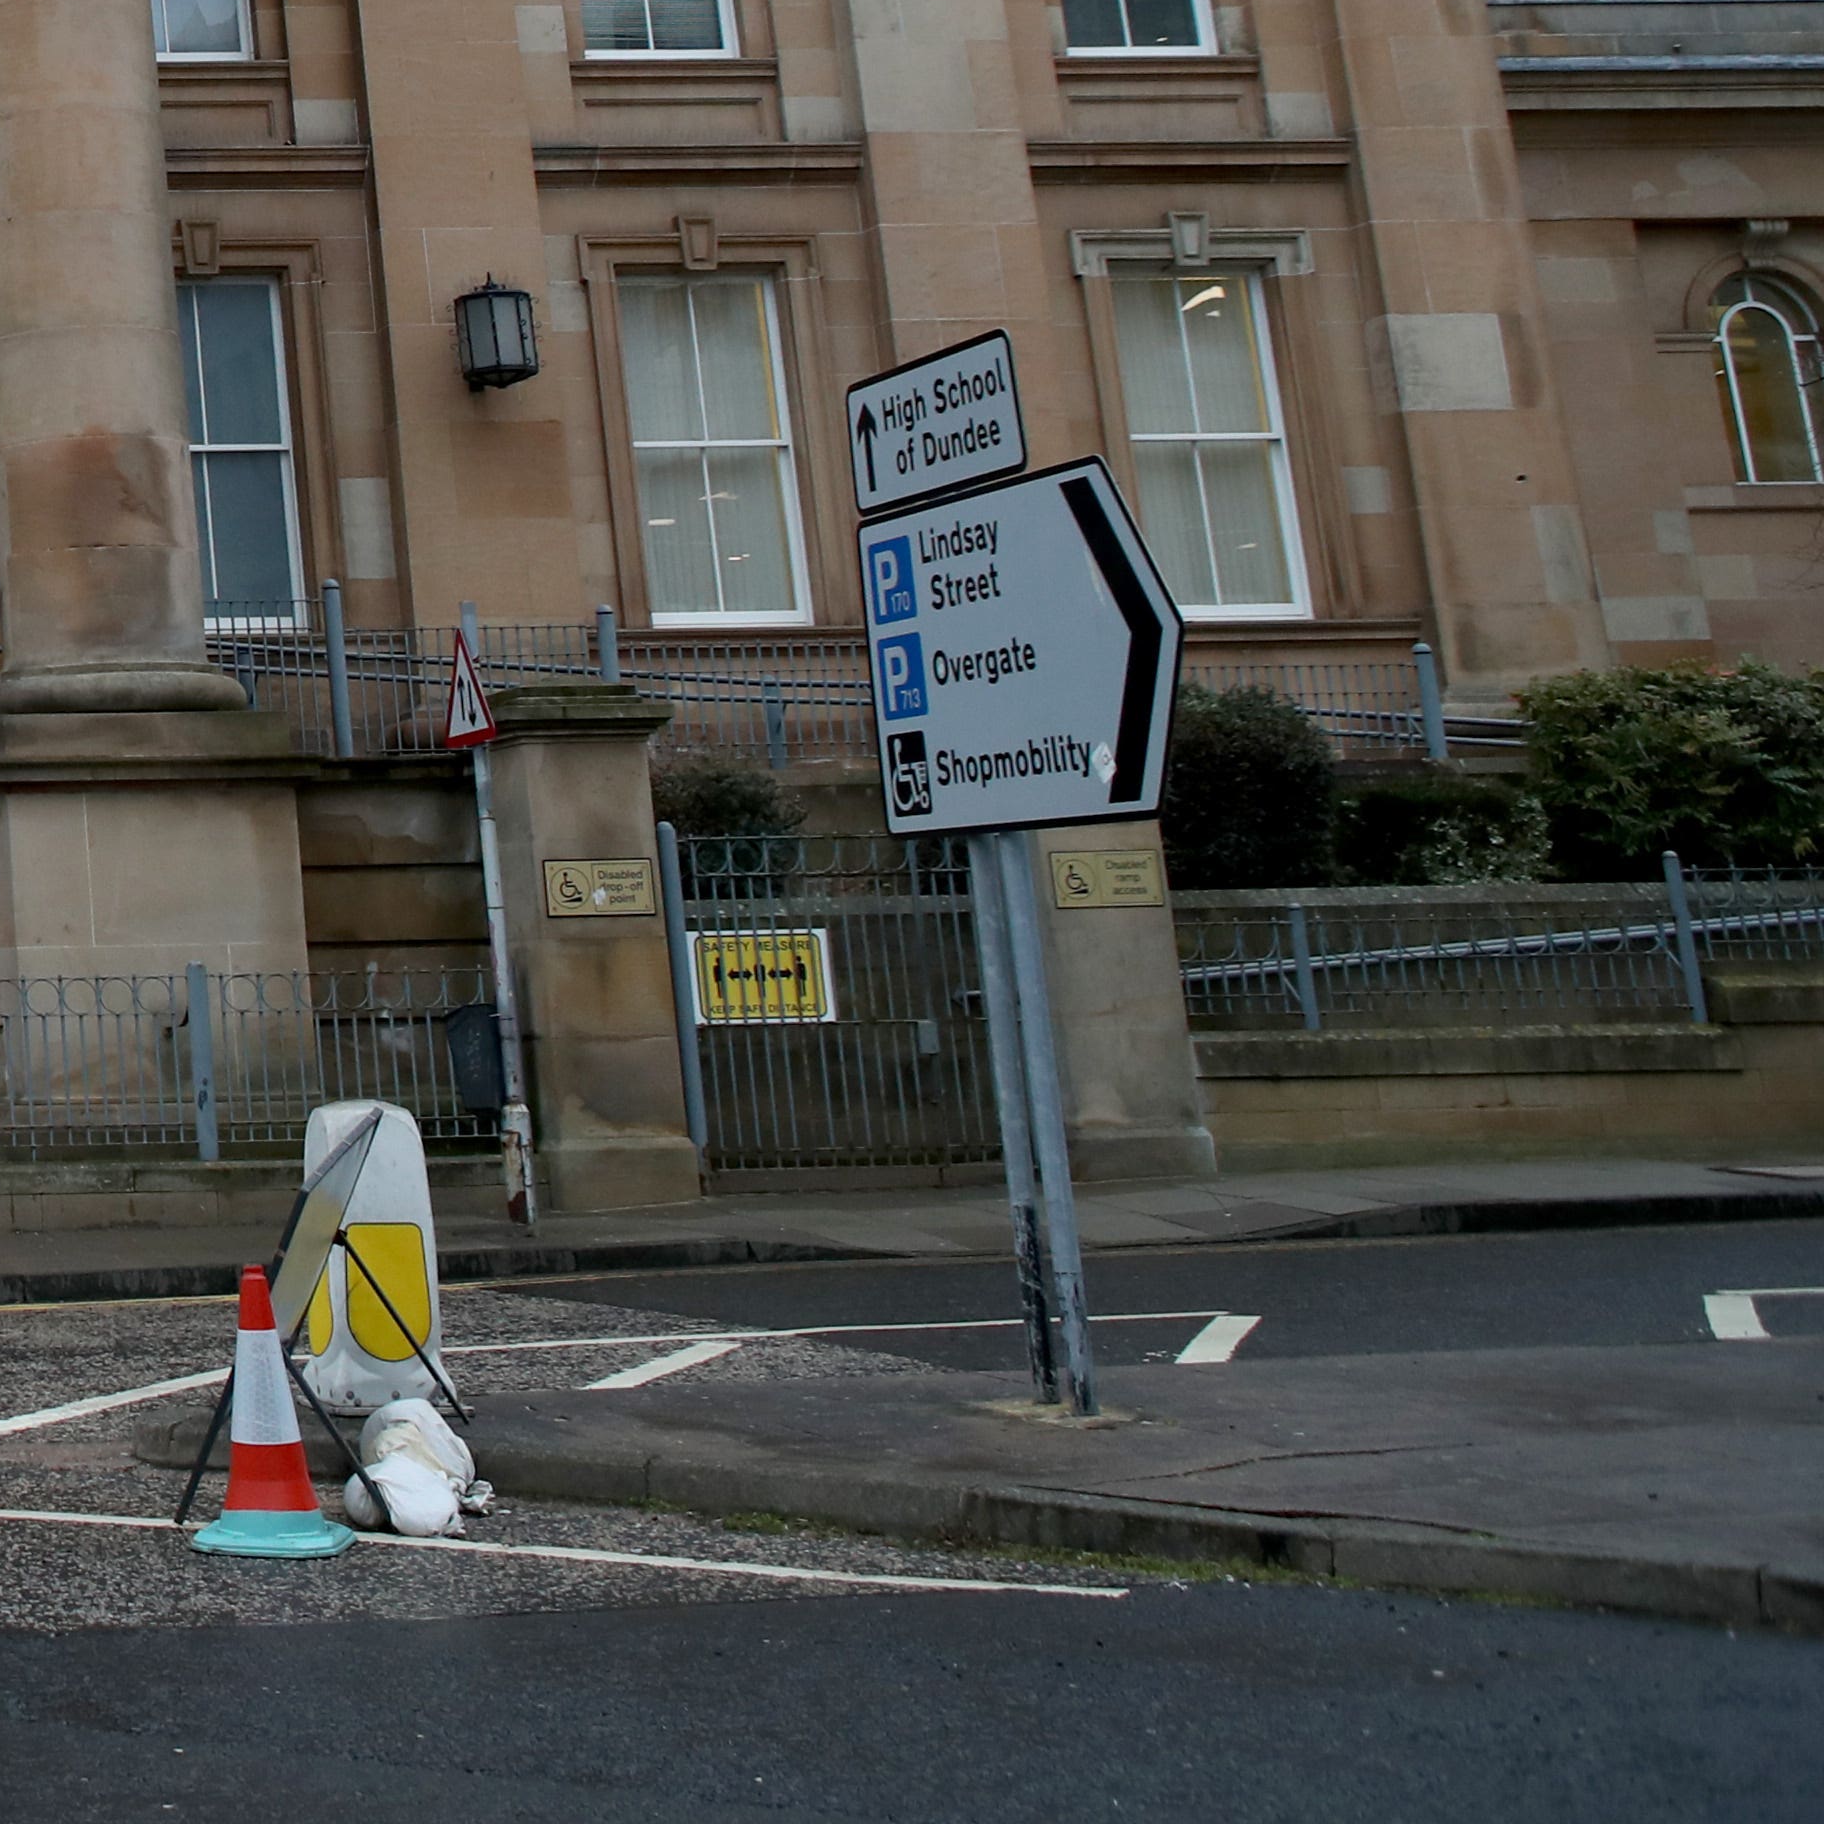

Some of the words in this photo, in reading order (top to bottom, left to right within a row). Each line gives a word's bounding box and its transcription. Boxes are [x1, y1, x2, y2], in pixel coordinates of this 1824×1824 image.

[882, 387, 927, 432] High
[933, 358, 1006, 414] School
[896, 437, 915, 475] of
[922, 418, 1001, 466] Dundee
[919, 521, 998, 564] Lindsay
[874, 550, 899, 616] P
[891, 591, 911, 613] 170
[931, 562, 1000, 610] Street
[883, 646, 909, 712] P
[933, 637, 1036, 685] Overgate
[900, 688, 921, 710] 713
[936, 734, 1091, 788] Shopmobility
[597, 870, 643, 879] Disabled
[609, 894, 636, 904] point
